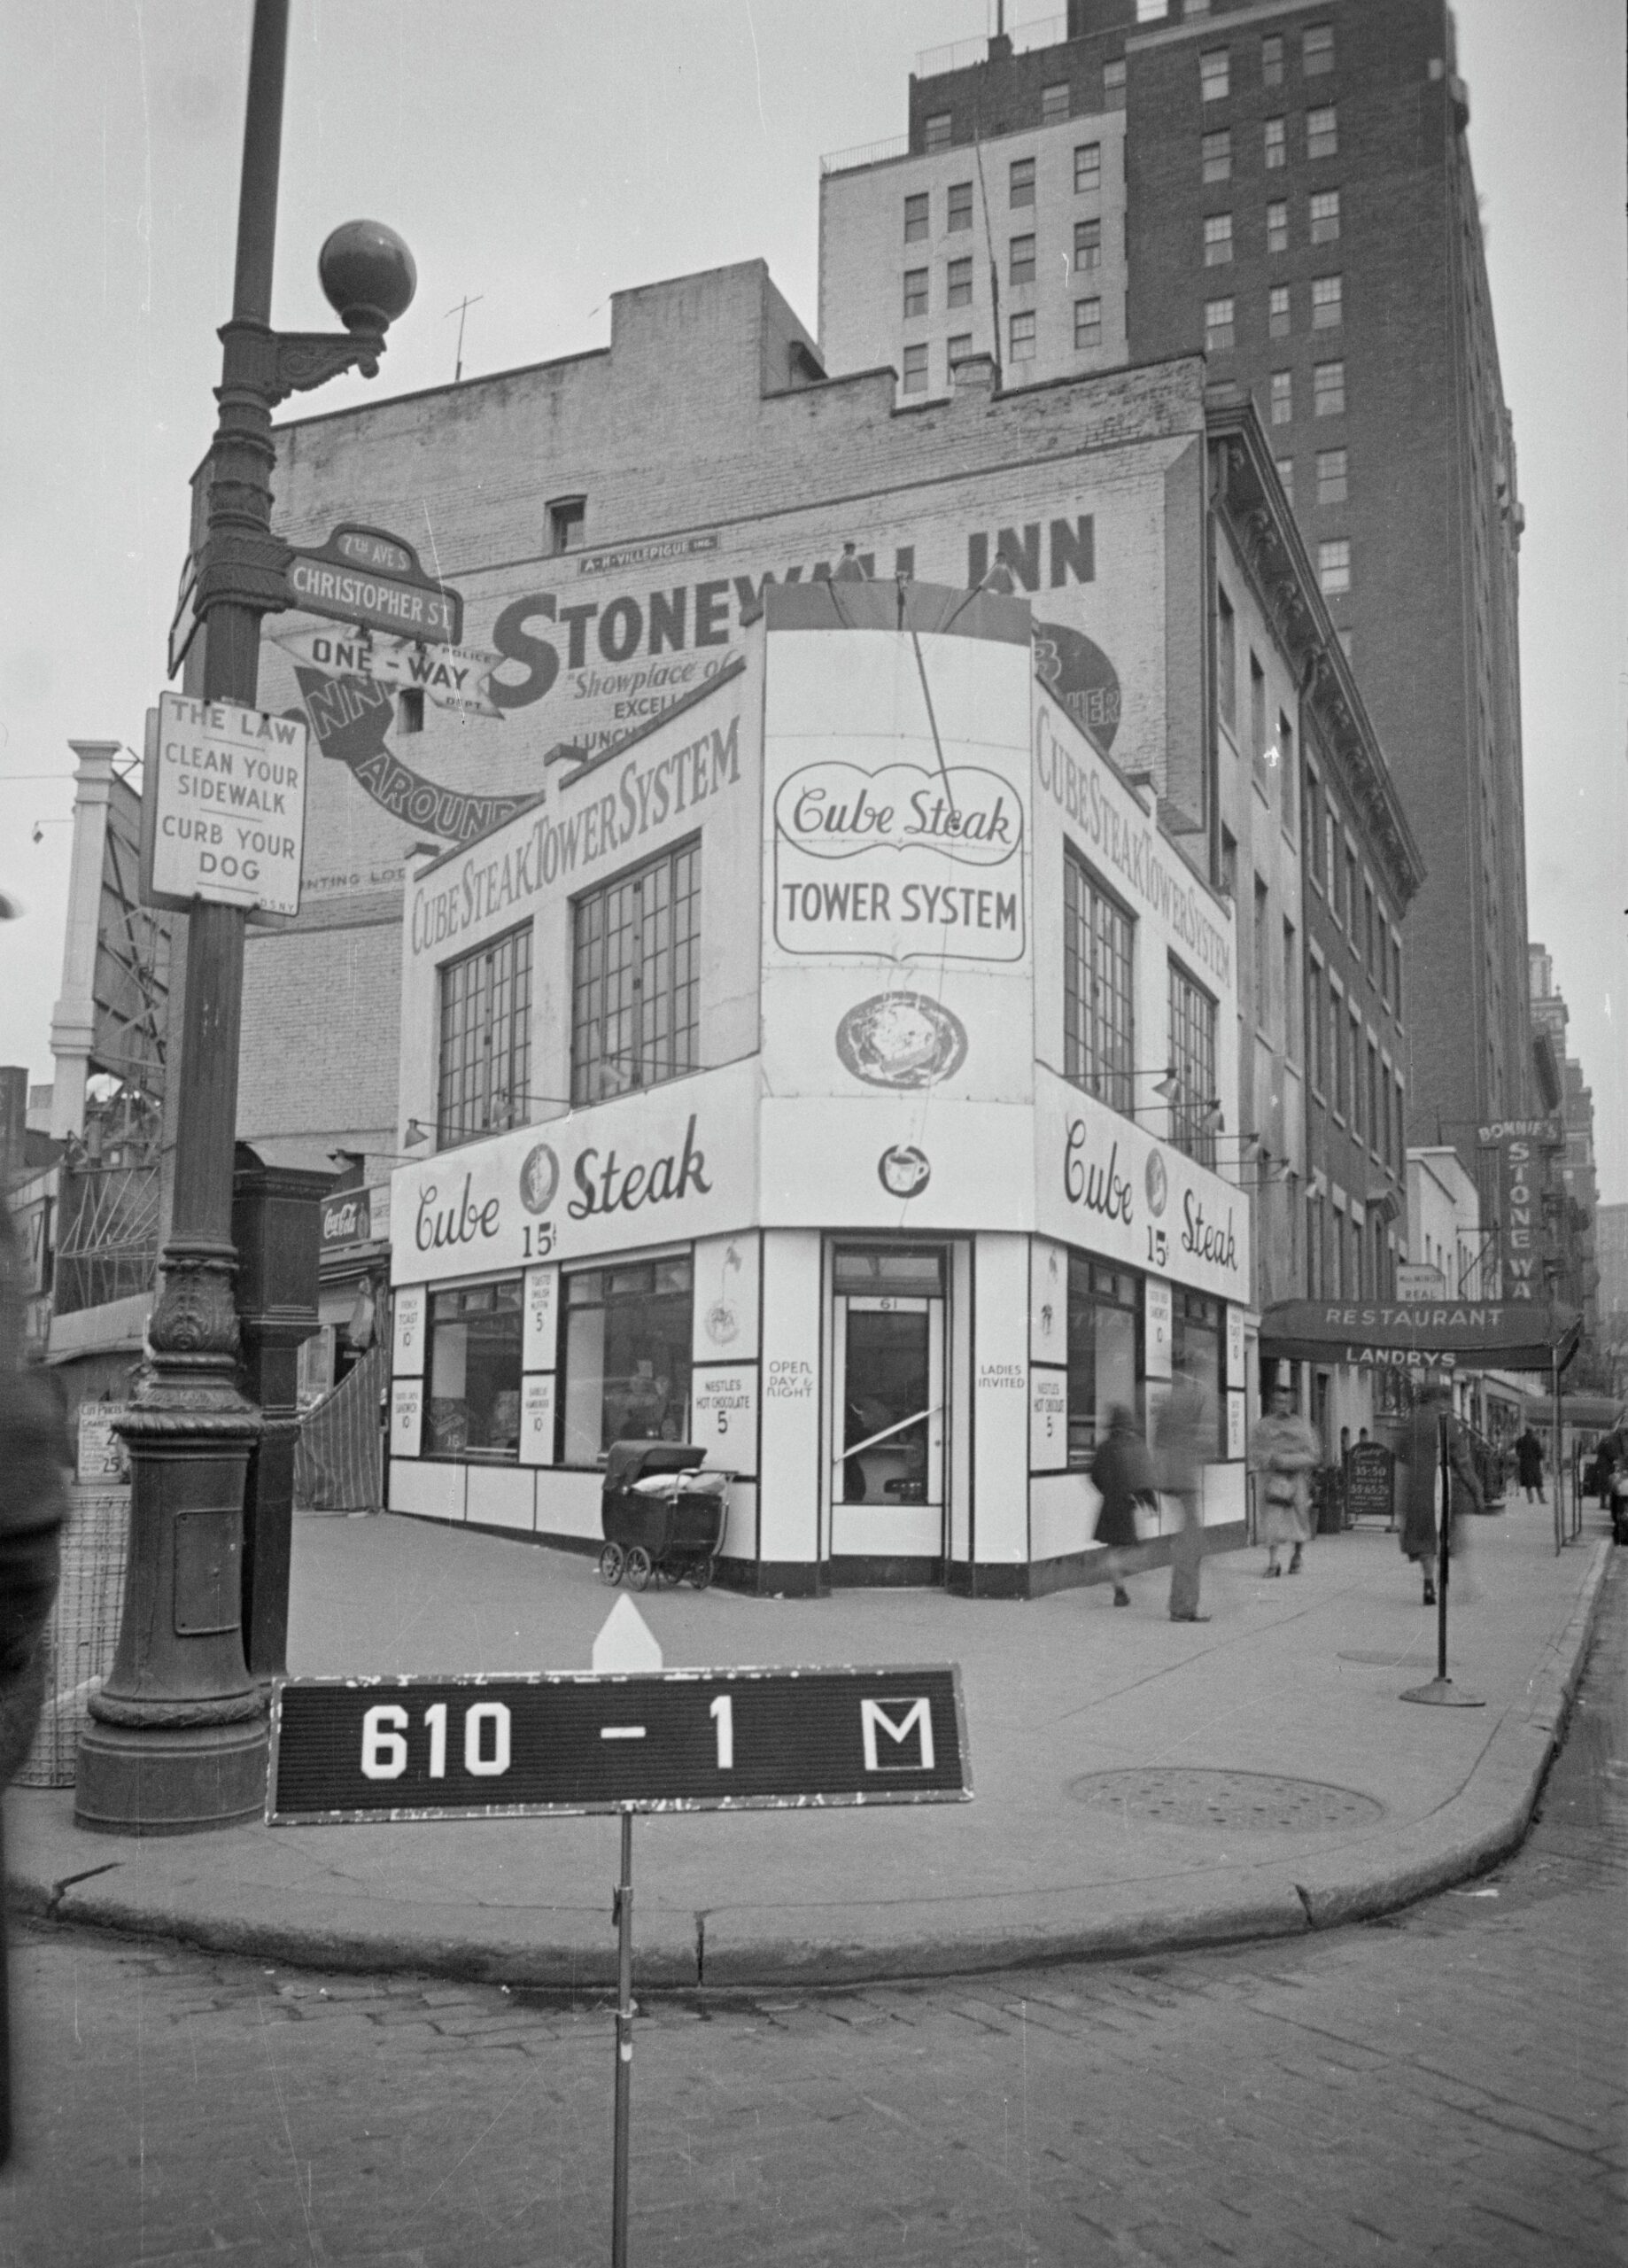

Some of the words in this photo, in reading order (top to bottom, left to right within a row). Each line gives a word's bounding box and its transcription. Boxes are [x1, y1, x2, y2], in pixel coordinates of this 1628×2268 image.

[344, 533, 370, 556] 7TH
[372, 544, 395, 570] AVE
[397, 553, 408, 571] S
[967, 513, 1097, 592] INN
[292, 565, 423, 623] CHRISTOPHER
[429, 601, 450, 627] ST
[313, 638, 372, 672] ONE
[407, 655, 469, 691] WAY
[443, 648, 492, 664] POLICE
[169, 698, 225, 730] THE
[241, 712, 298, 746] LAW
[165, 742, 233, 777] CLEAN
[244, 757, 298, 788] YOUR
[619, 714, 741, 845] SYSTEM
[178, 774, 286, 816] SIDEWALK
[793, 785, 895, 834] Cube
[903, 789, 1012, 844] Steak
[162, 815, 223, 845] CURB
[237, 829, 296, 860] YOUR
[198, 851, 260, 882] DOG
[260, 897, 295, 914] DSNY
[781, 882, 891, 922] TOWER
[900, 884, 1017, 932] SYSTEM
[416, 1171, 500, 1252] Cube
[567, 1113, 714, 1221] Steak
[1063, 1111, 1134, 1226] Cube
[1181, 1188, 1238, 1272] Steak
[1508, 1141, 1533, 1300] STONEWA
[880, 1298, 898, 1309] 61
[1326, 1308, 1505, 1328] RESTAURANT
[536, 1311, 544, 1332] 5
[769, 1360, 813, 1374] OPEN
[981, 1364, 1022, 1376] LADIES
[1345, 1347, 1457, 1368] LANDRYS
[766, 1386, 813, 1398] NIGHT
[769, 1375, 799, 1387] DAY
[979, 1377, 1026, 1389] INVITED
[695, 1397, 710, 1410] HOT
[711, 1394, 750, 1410] CHOCOLATE
[717, 1410, 729, 1434] 5
[1047, 1415, 1053, 1438] 5
[360, 1701, 512, 1780] 610
[709, 1694, 733, 1770] 1
[860, 1697, 936, 1772] M
